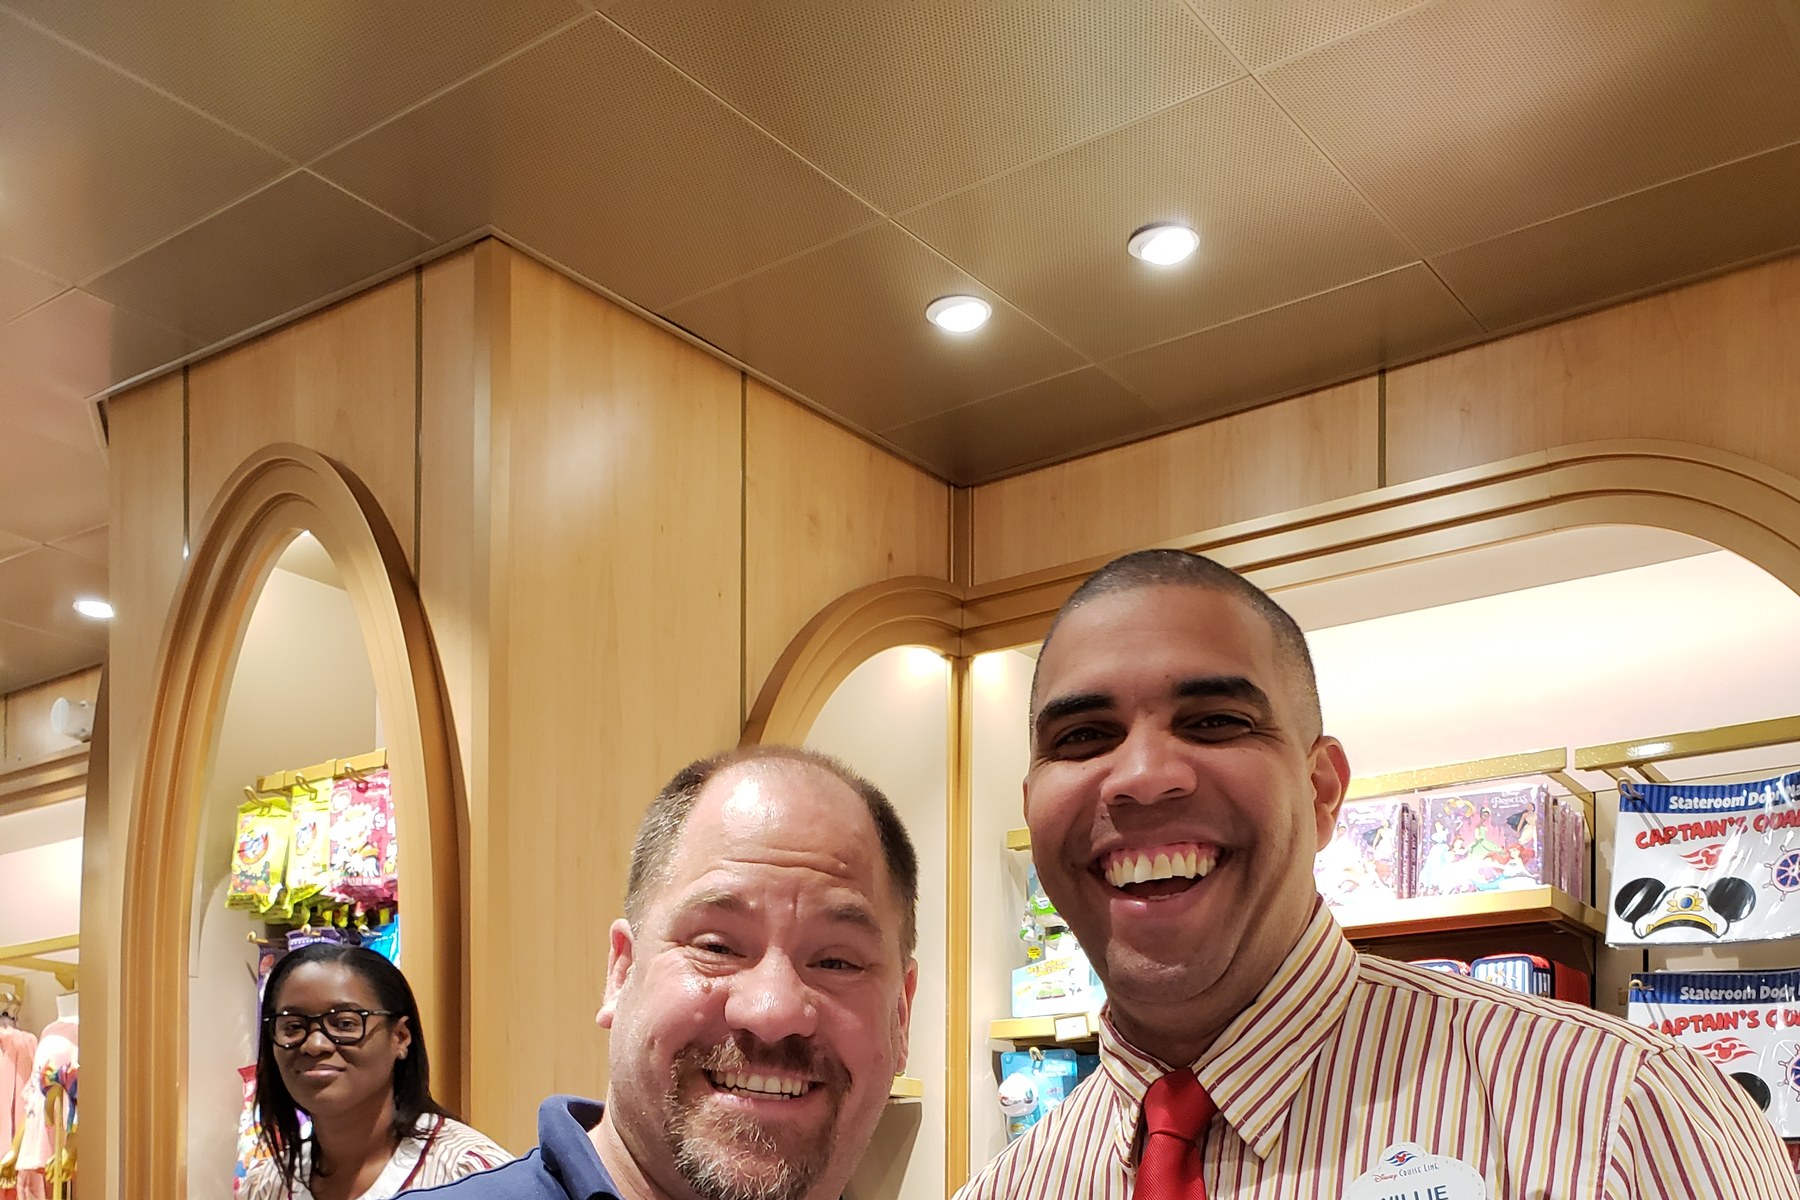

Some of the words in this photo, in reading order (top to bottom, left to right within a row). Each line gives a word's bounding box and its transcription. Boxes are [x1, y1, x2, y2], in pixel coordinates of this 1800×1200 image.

[1669, 795, 1745, 810] Stateroom
[1635, 815, 1748, 849] CAPTAIN'S
[1680, 986, 1756, 1001] Stateroom
[1760, 985, 1796, 1000] Door
[1649, 1009, 1760, 1037] APTAIN'S
